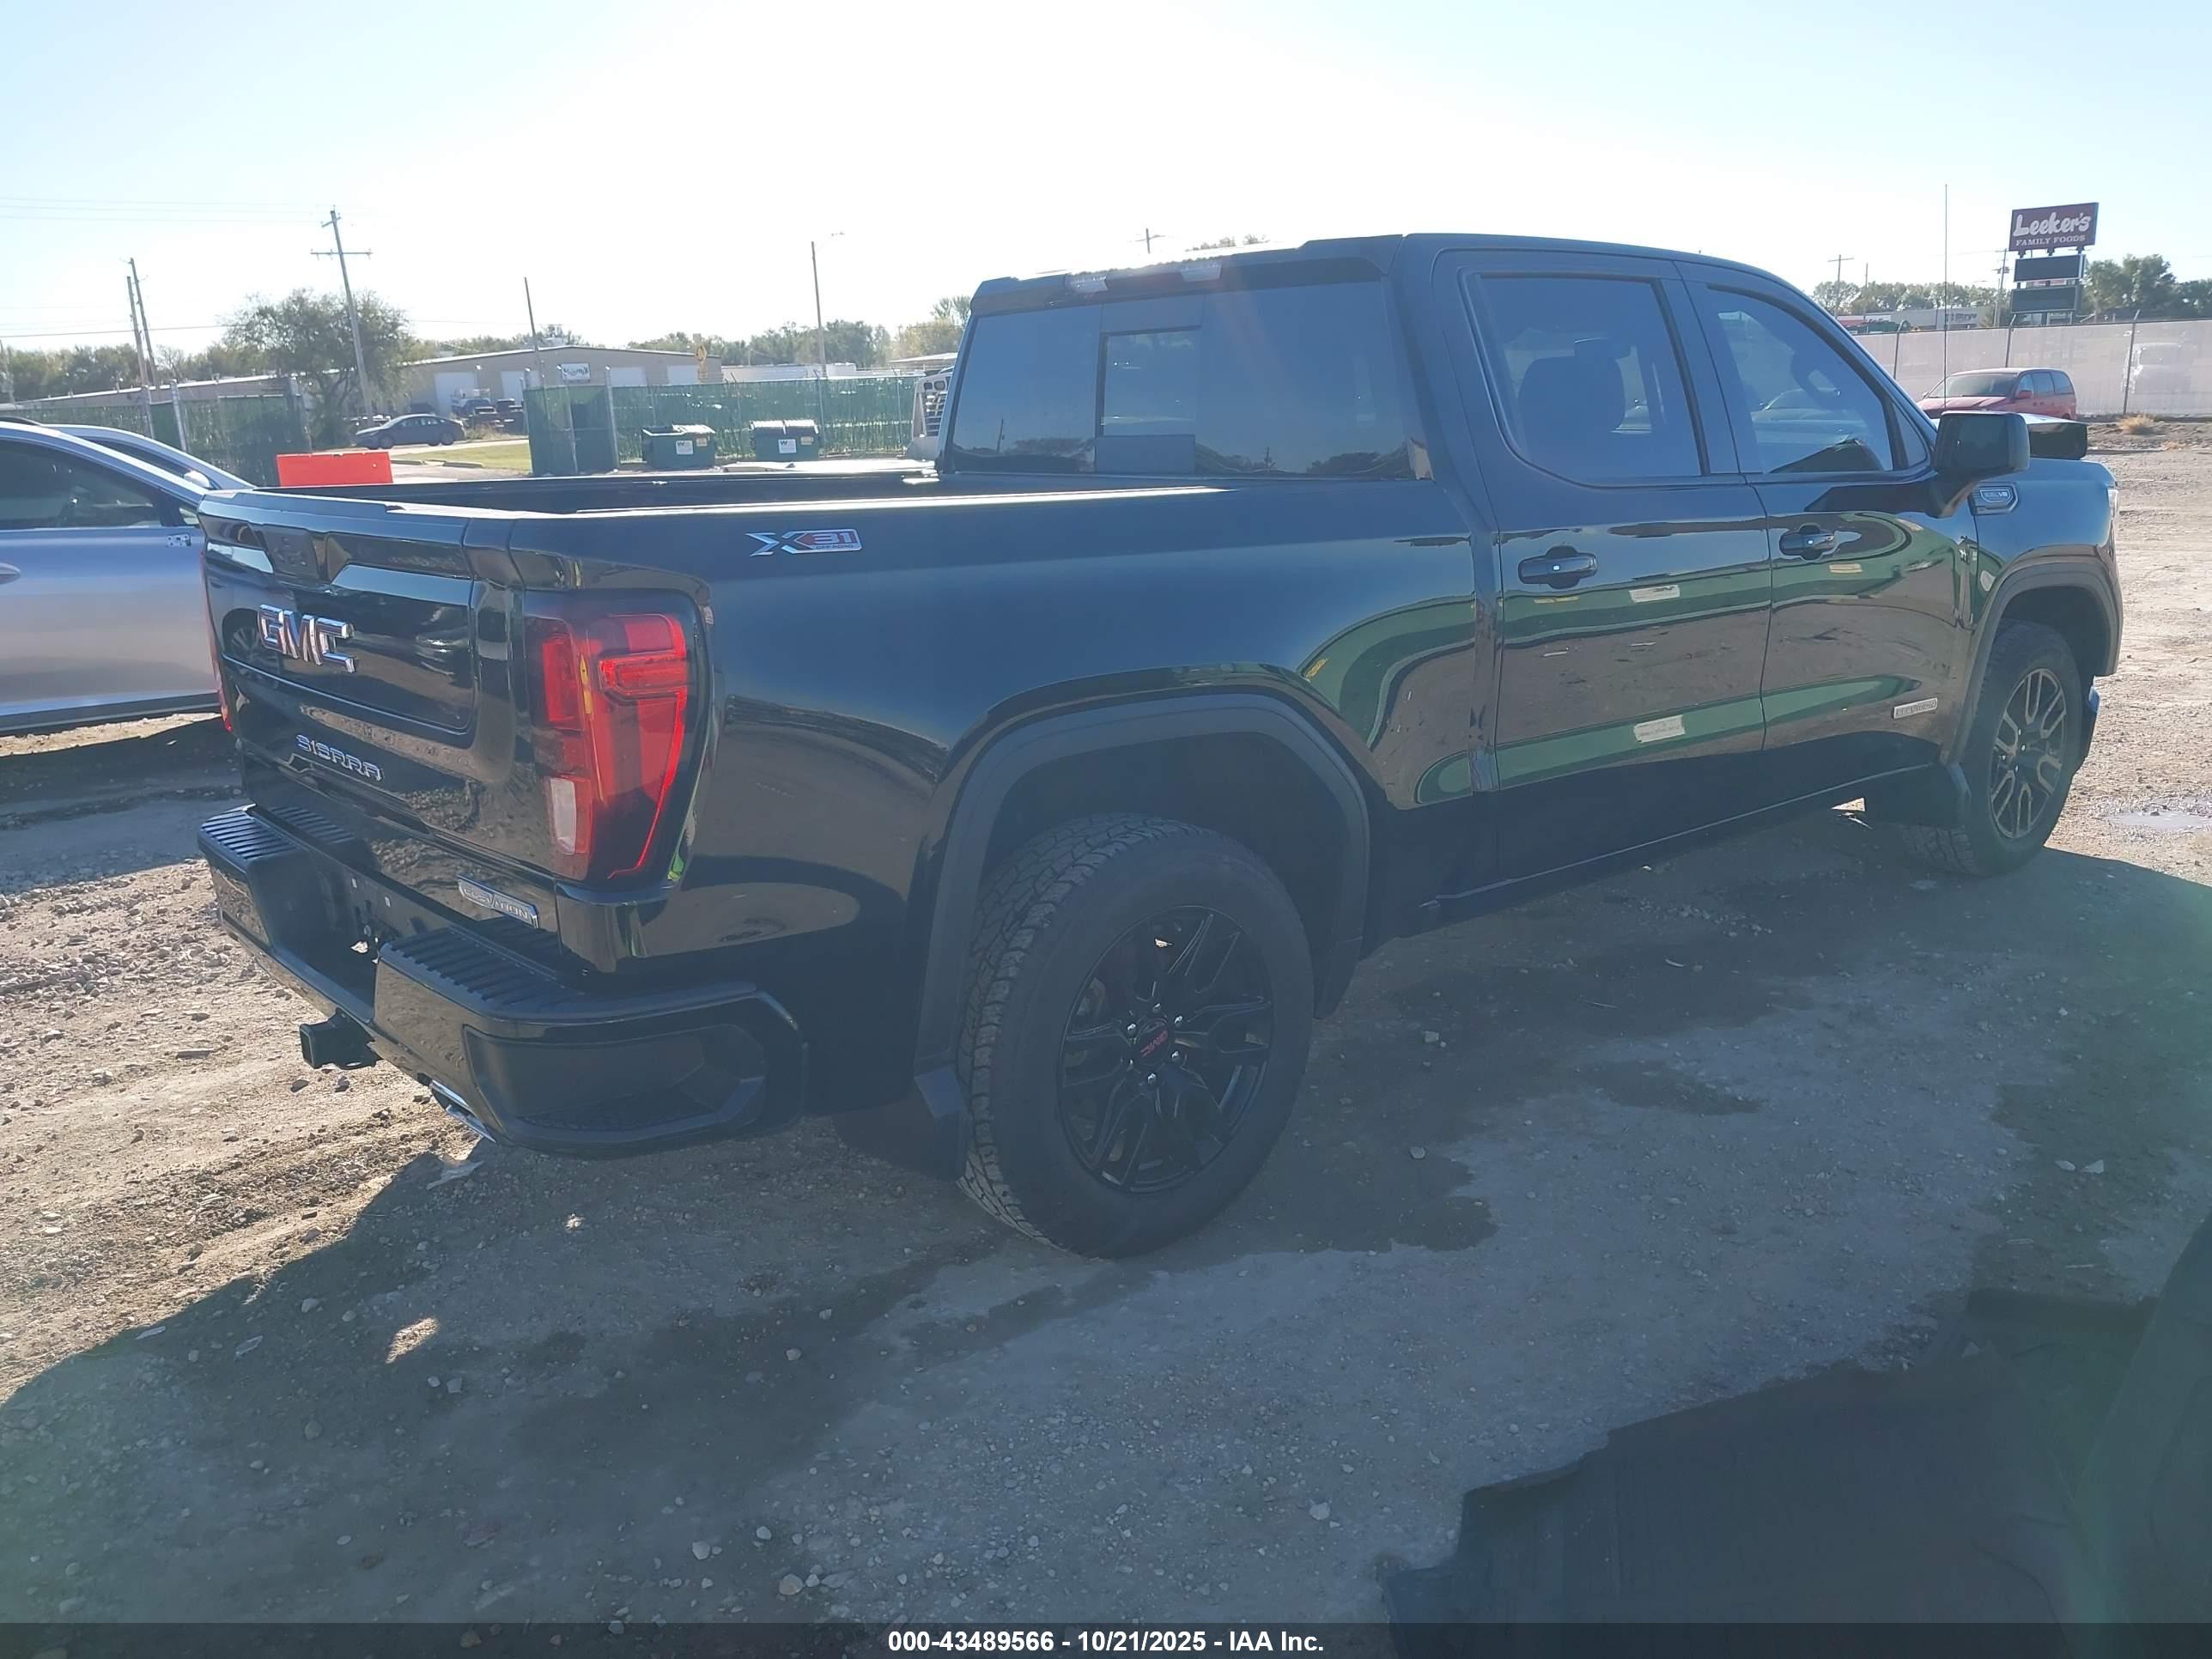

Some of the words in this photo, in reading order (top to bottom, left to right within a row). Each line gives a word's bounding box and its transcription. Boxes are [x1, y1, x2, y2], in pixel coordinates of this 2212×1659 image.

[2013, 212, 2092, 237] Leeker's
[2016, 238, 2051, 246] FAMILY
[2053, 234, 2086, 244] FOODS
[744, 528, 859, 556] X31
[258, 604, 356, 673] GMC
[295, 734, 382, 781] SIERRA
